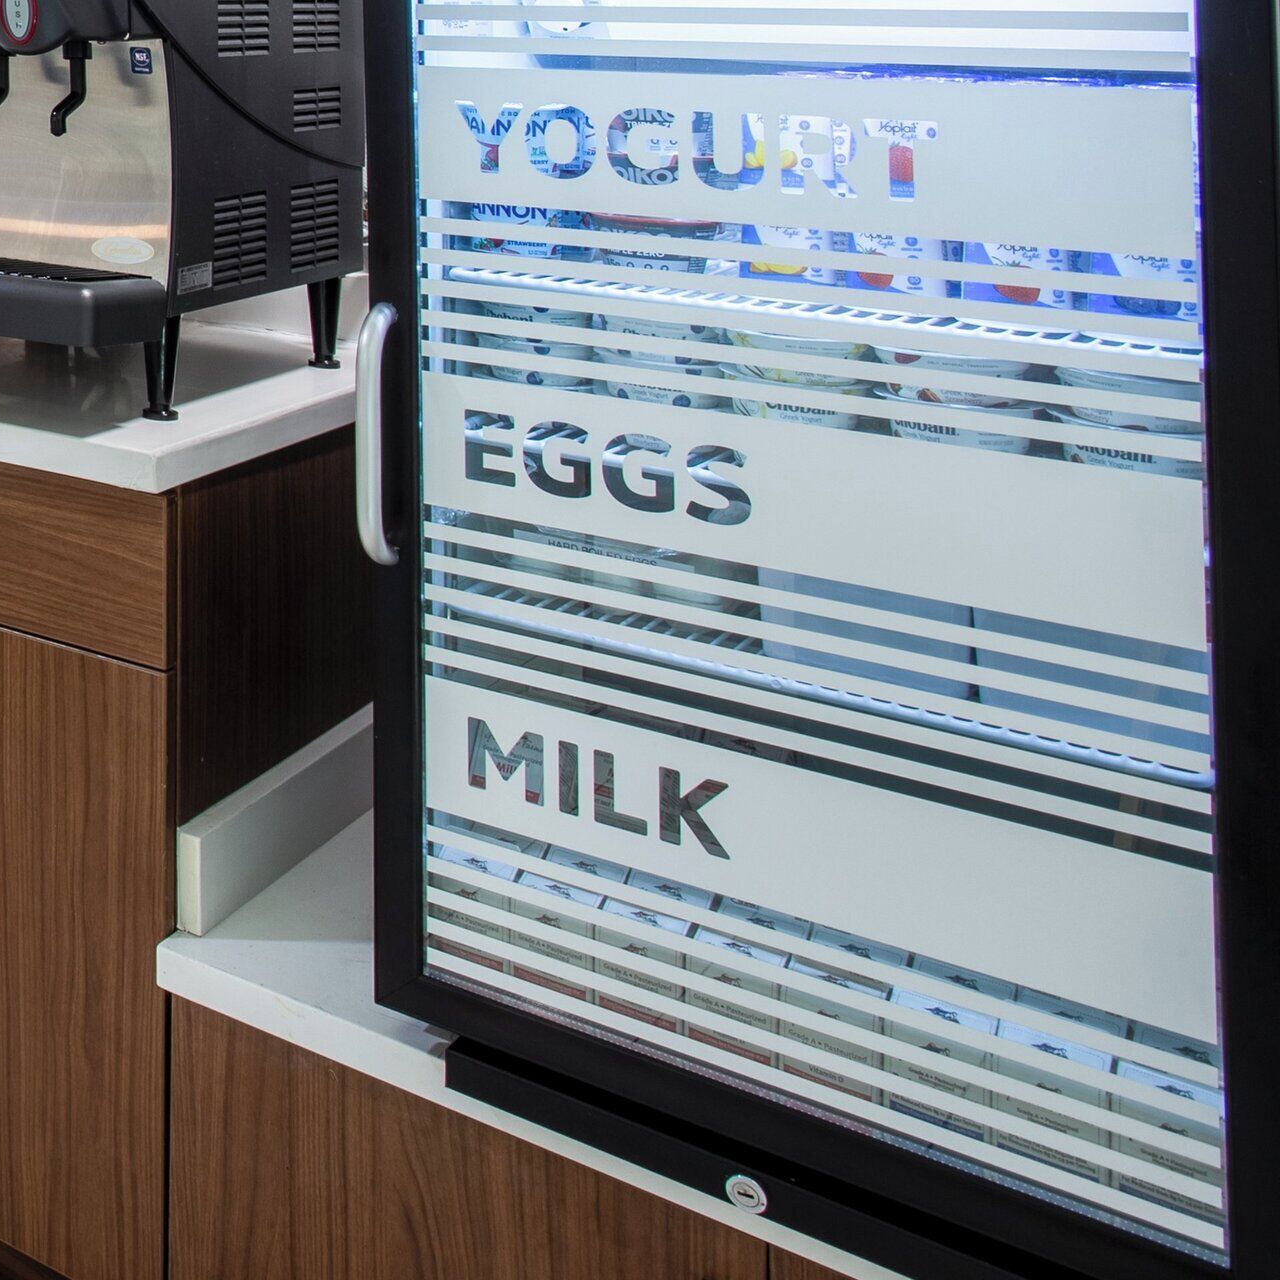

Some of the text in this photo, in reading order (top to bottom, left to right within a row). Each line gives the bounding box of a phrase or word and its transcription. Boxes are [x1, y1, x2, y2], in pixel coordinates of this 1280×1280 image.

[454, 99, 939, 202] YOGURT
[878, 120, 917, 136] Yoplait
[464, 409, 752, 526] EGGS
[468, 716, 730, 860] MILK
